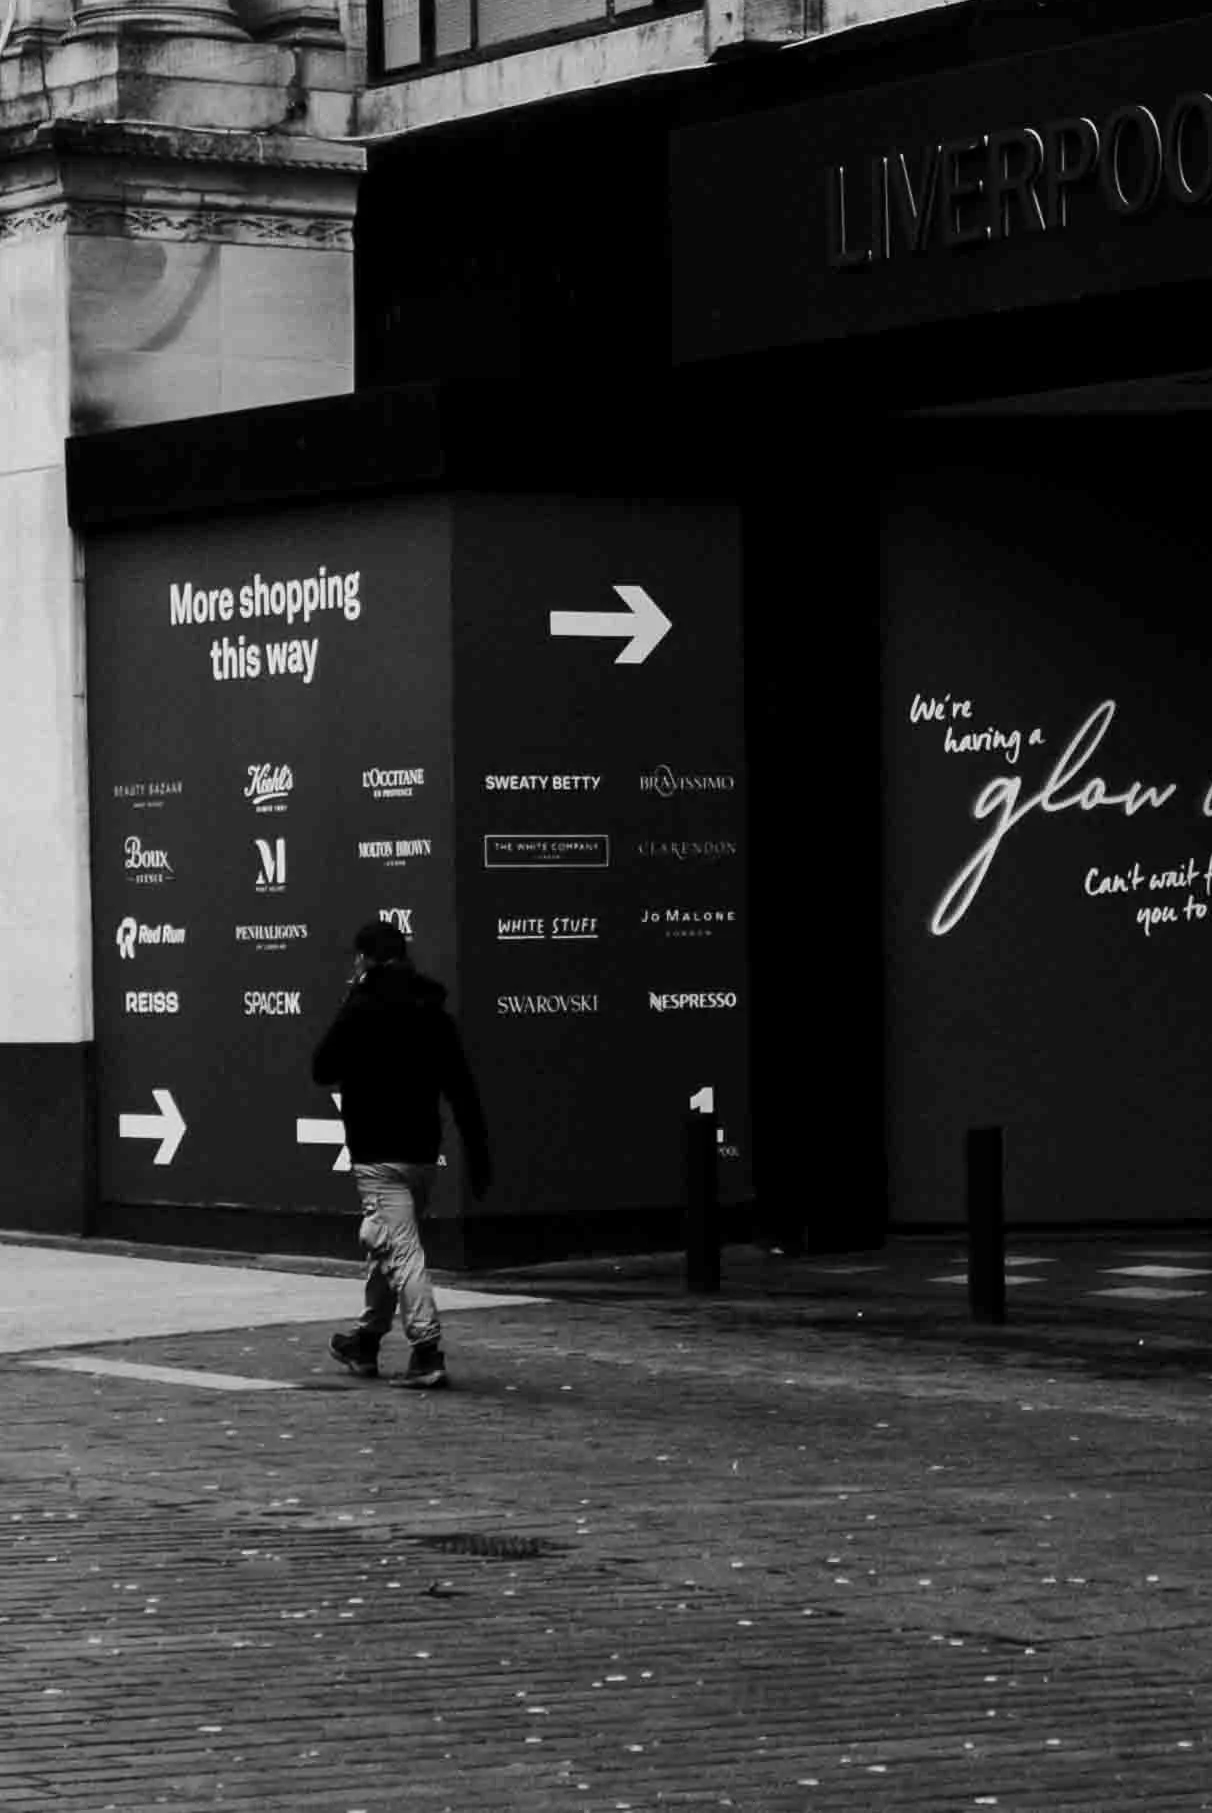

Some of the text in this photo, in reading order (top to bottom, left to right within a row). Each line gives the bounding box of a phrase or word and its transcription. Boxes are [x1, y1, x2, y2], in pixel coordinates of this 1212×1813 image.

[169, 565, 361, 626] More shopping
[209, 635, 319, 684] this way
[910, 693, 974, 724] We're
[943, 726, 1047, 764] having a
[244, 763, 294, 798] Kiehl's
[484, 774, 601, 791] SWEATY BETTY
[639, 765, 736, 797] BRAVISSIMO
[930, 698, 1177, 936] glow
[1084, 862, 1142, 897] Can't
[1148, 857, 1200, 892] wait
[497, 917, 599, 934] WHITE STUFF
[665, 907, 737, 923] MALONE
[1136, 903, 1178, 937] you
[1183, 894, 1209, 922] to
[125, 991, 180, 1014] REISS
[496, 992, 599, 1016] SWAROVSKI
[648, 989, 738, 1014] NESPRESSO
